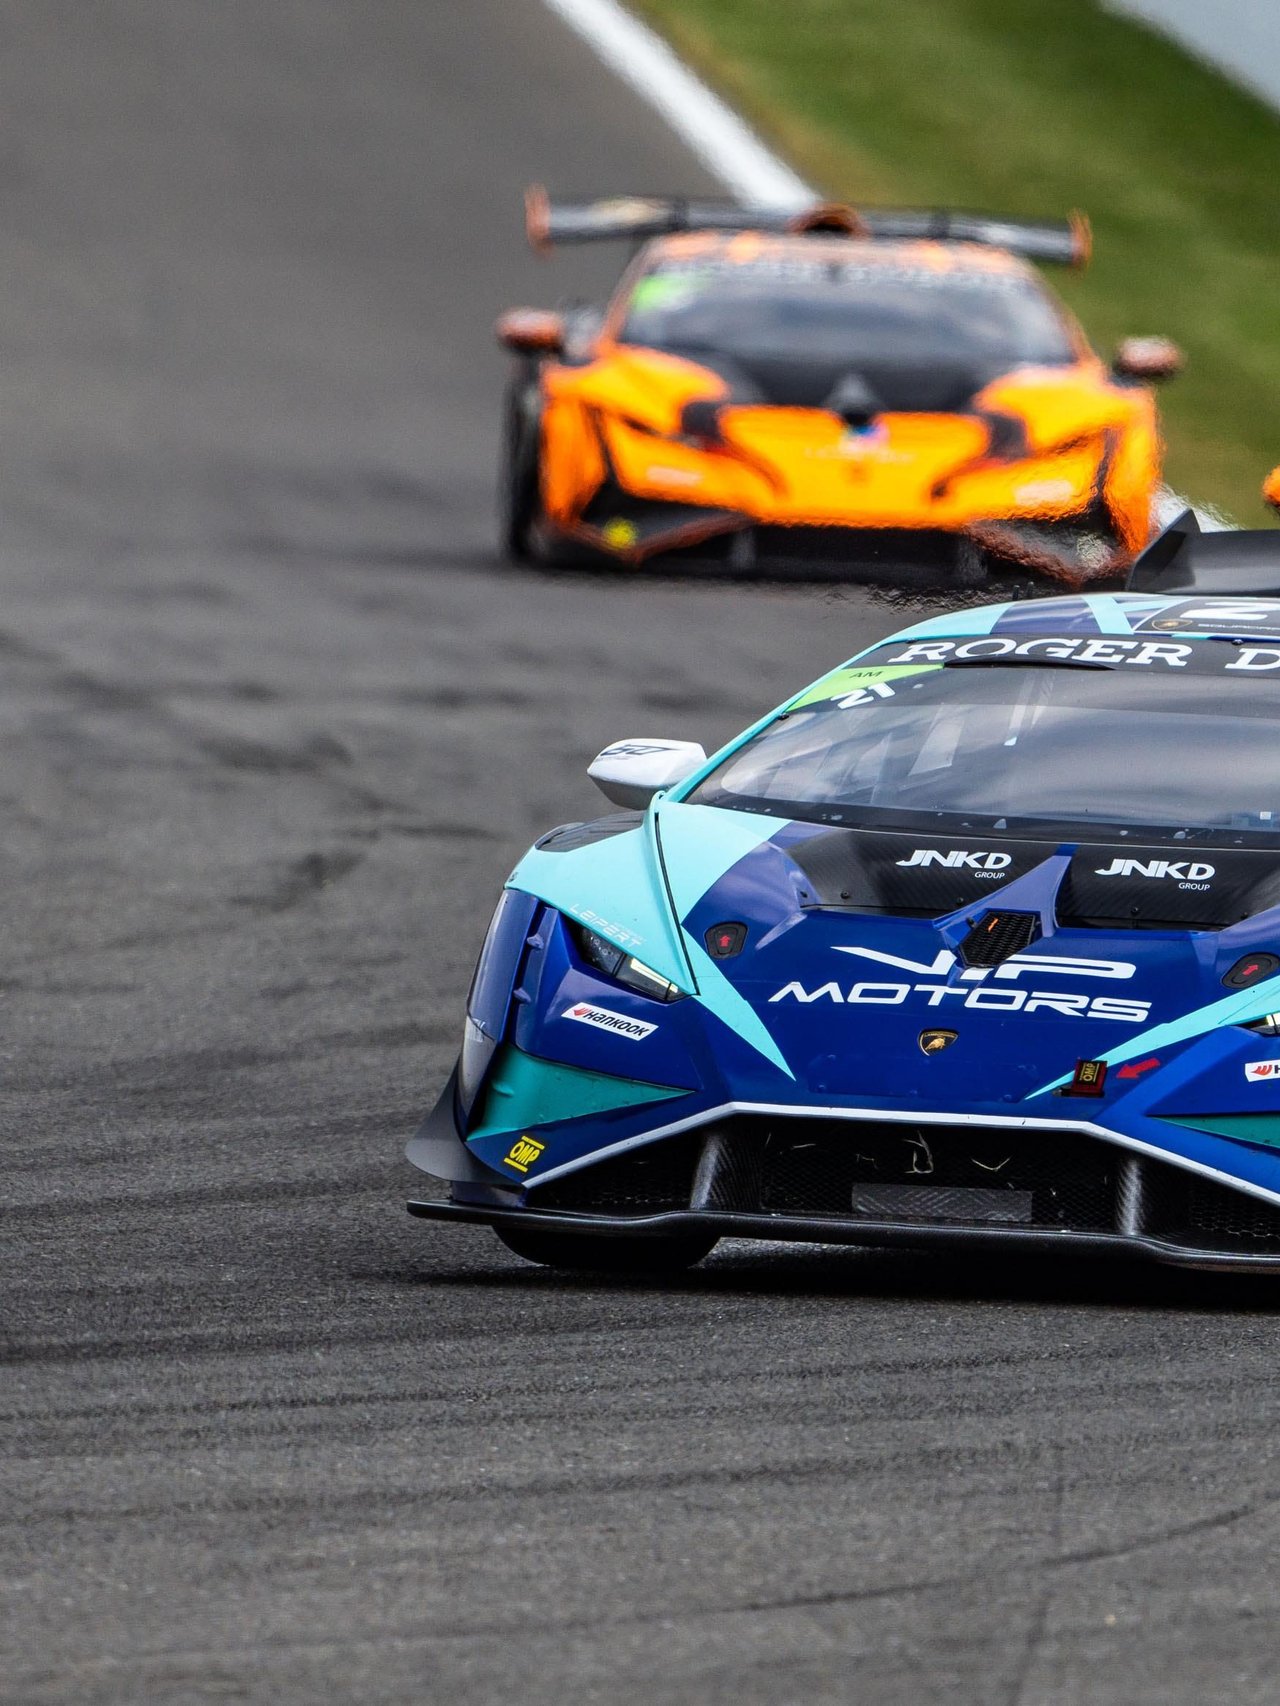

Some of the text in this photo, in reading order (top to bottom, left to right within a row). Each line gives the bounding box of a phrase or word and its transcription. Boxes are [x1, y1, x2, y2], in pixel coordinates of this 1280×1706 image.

[887, 637, 1193, 667] ROGER
[849, 670, 883, 679] AM
[830, 682, 896, 710] 21
[895, 849, 1012, 870] JNKD
[1094, 858, 1216, 881] JNKD
[974, 870, 1006, 880] GROUP
[1178, 882, 1211, 892] GROUP
[569, 903, 642, 948] LEIPERT
[830, 946, 1137, 980] VIP
[768, 981, 1153, 1023] MOTORS
[1083, 1062, 1096, 1082] OMP
[510, 1141, 541, 1166] OMP
